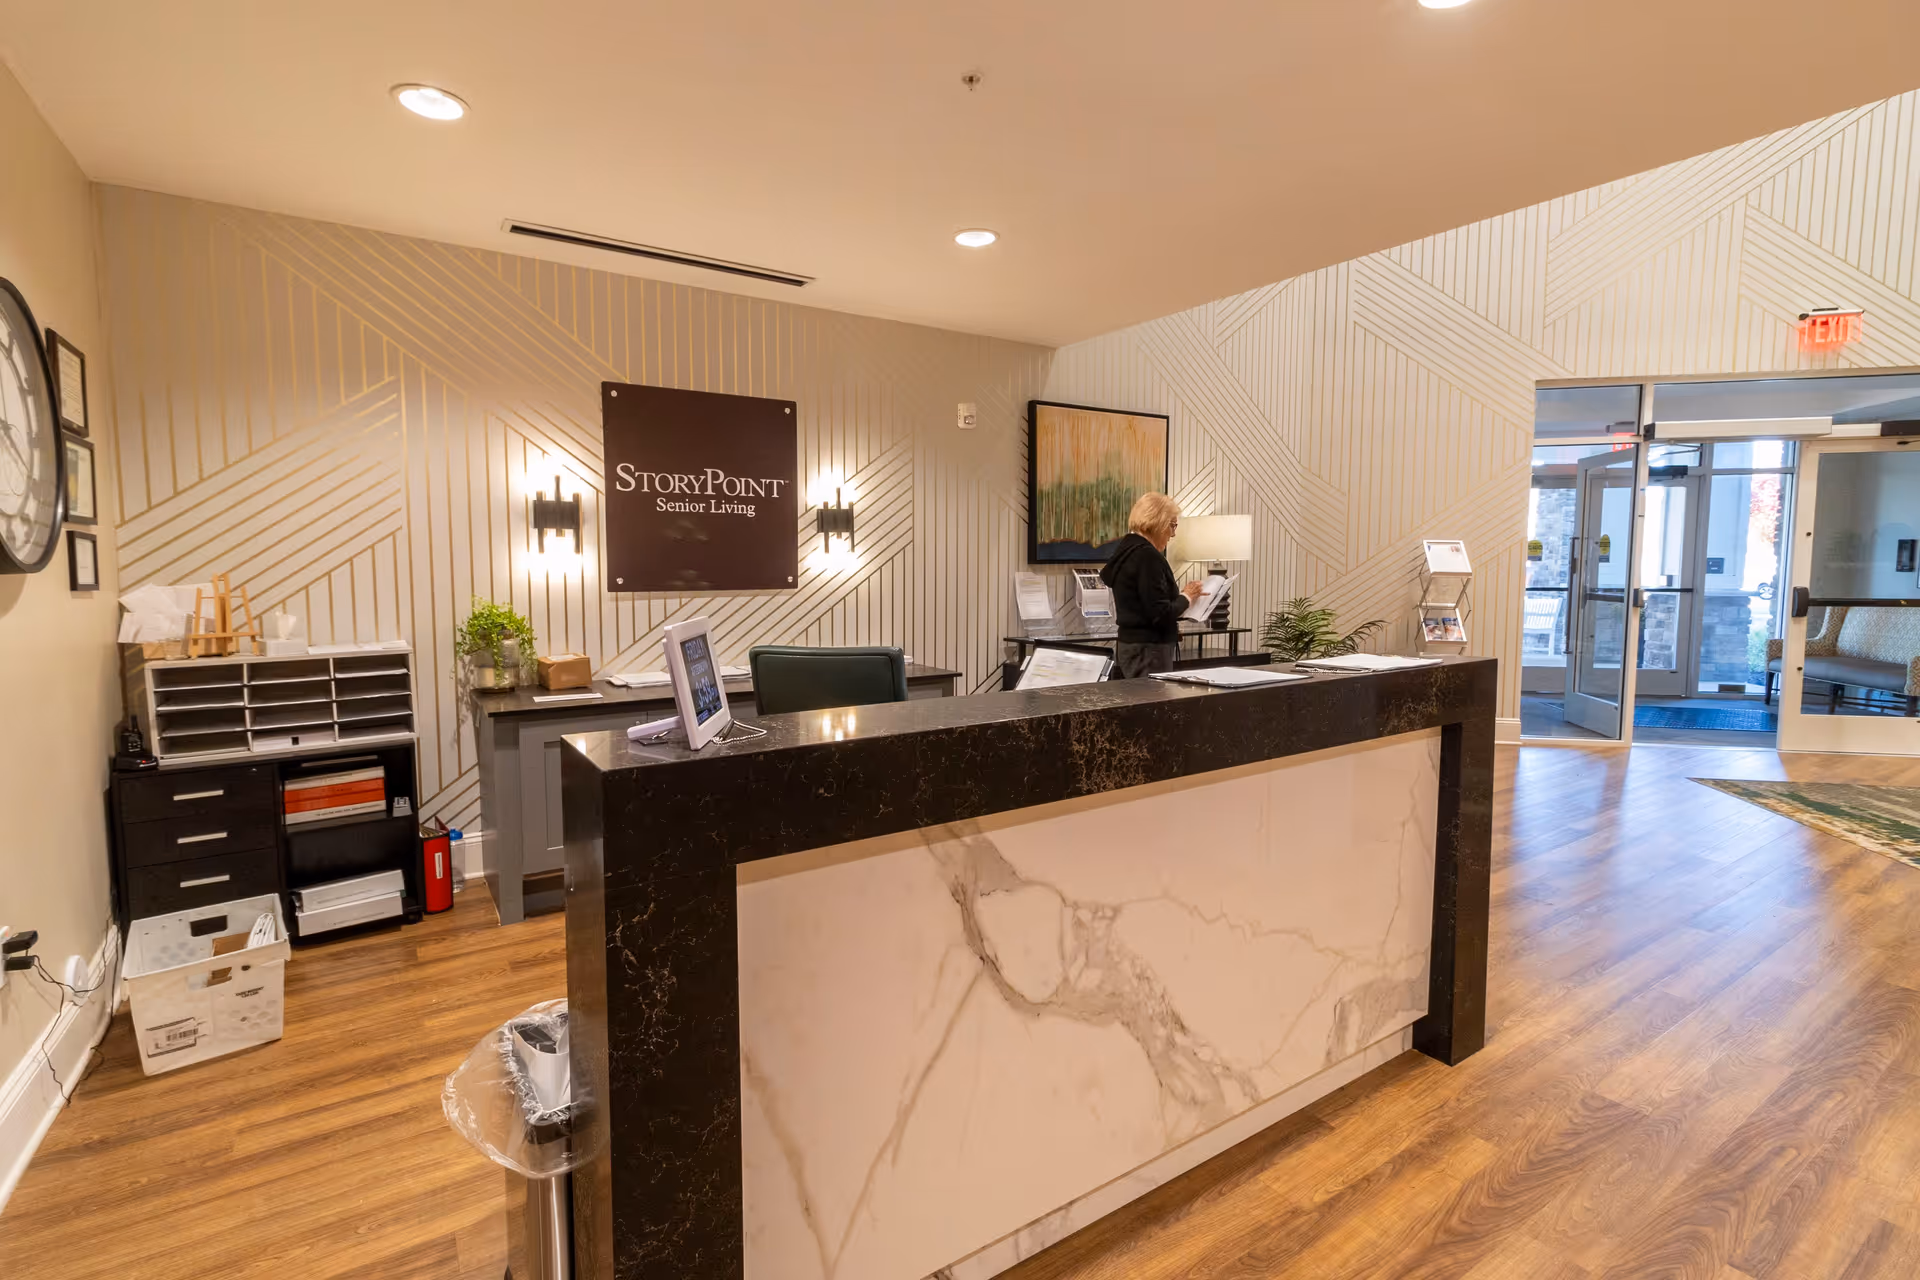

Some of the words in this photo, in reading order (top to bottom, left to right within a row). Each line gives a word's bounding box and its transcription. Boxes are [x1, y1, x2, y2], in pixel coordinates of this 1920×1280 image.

[1815, 316, 1855, 343] EXIT
[656, 497, 706, 512] Senior
[710, 499, 756, 517] Living
